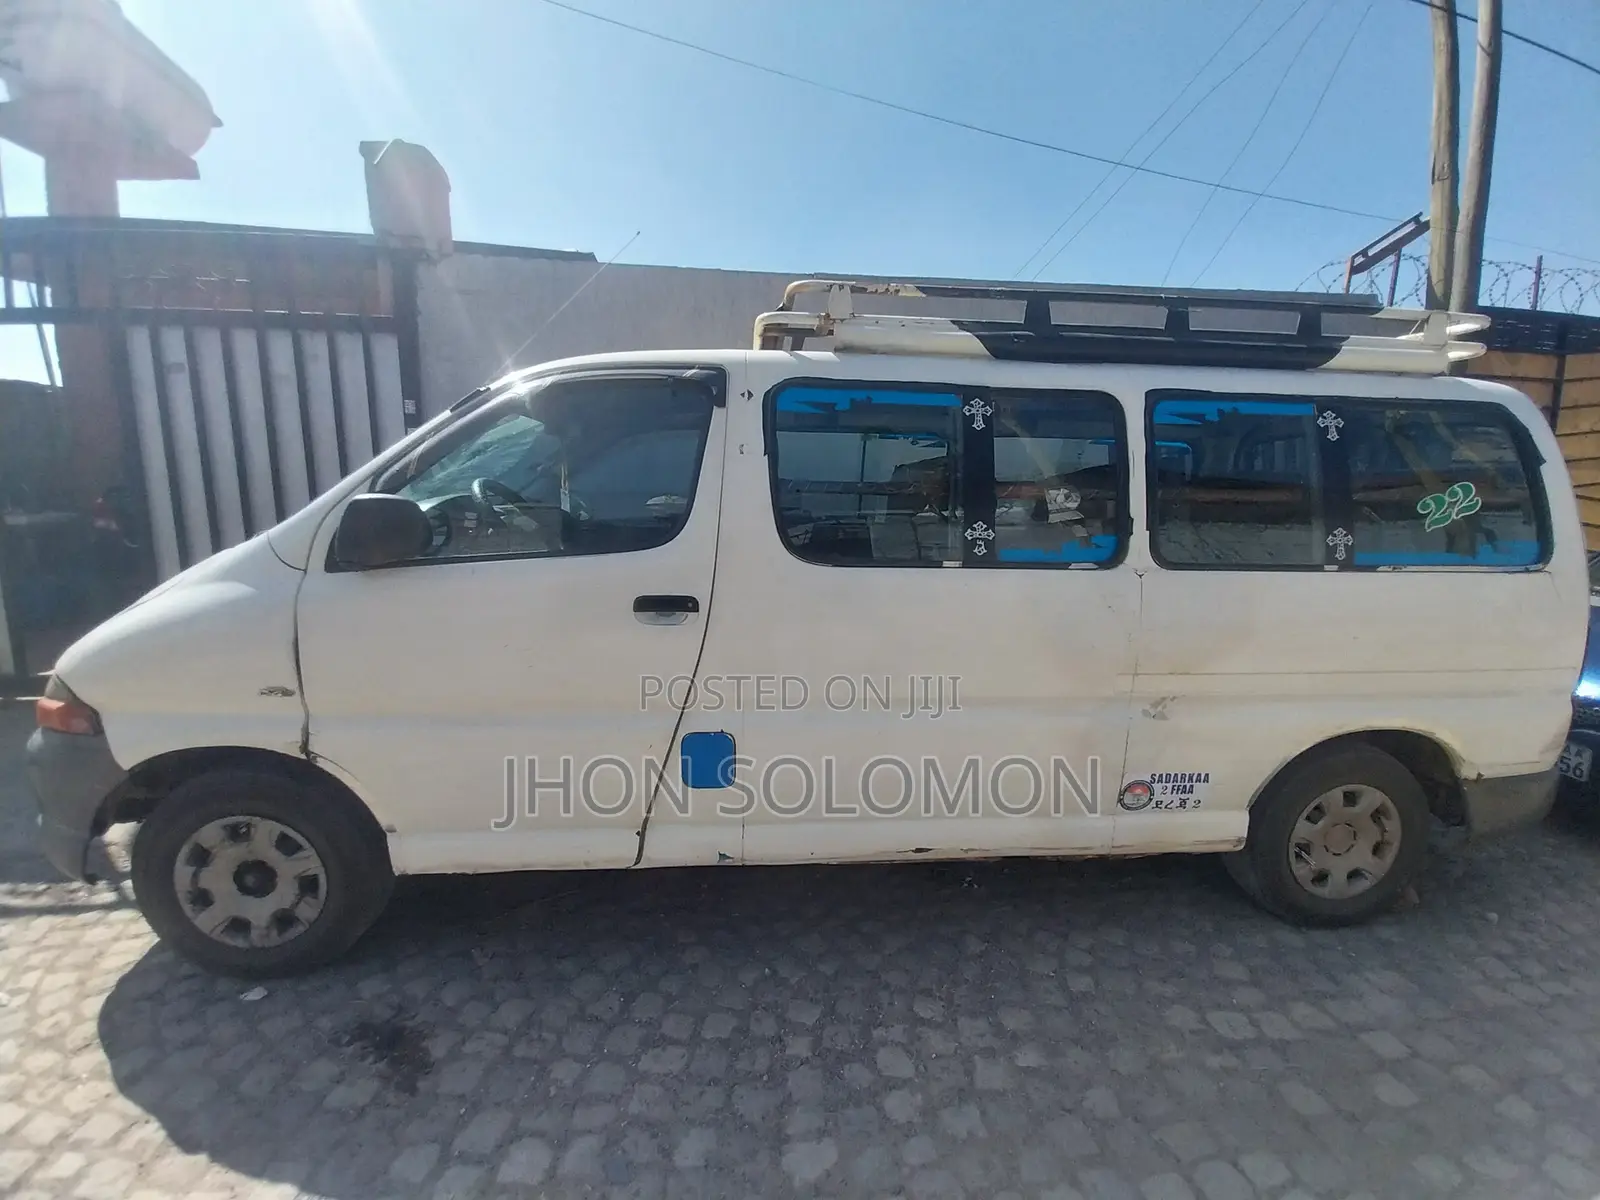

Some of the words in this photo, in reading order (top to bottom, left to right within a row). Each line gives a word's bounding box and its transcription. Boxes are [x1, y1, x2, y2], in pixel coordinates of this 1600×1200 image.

[1416, 481, 1482, 532] 22
[1150, 773, 1210, 784] SADARKAA
[1160, 786, 1168, 795] 2
[1170, 785, 1194, 795] FFAA
